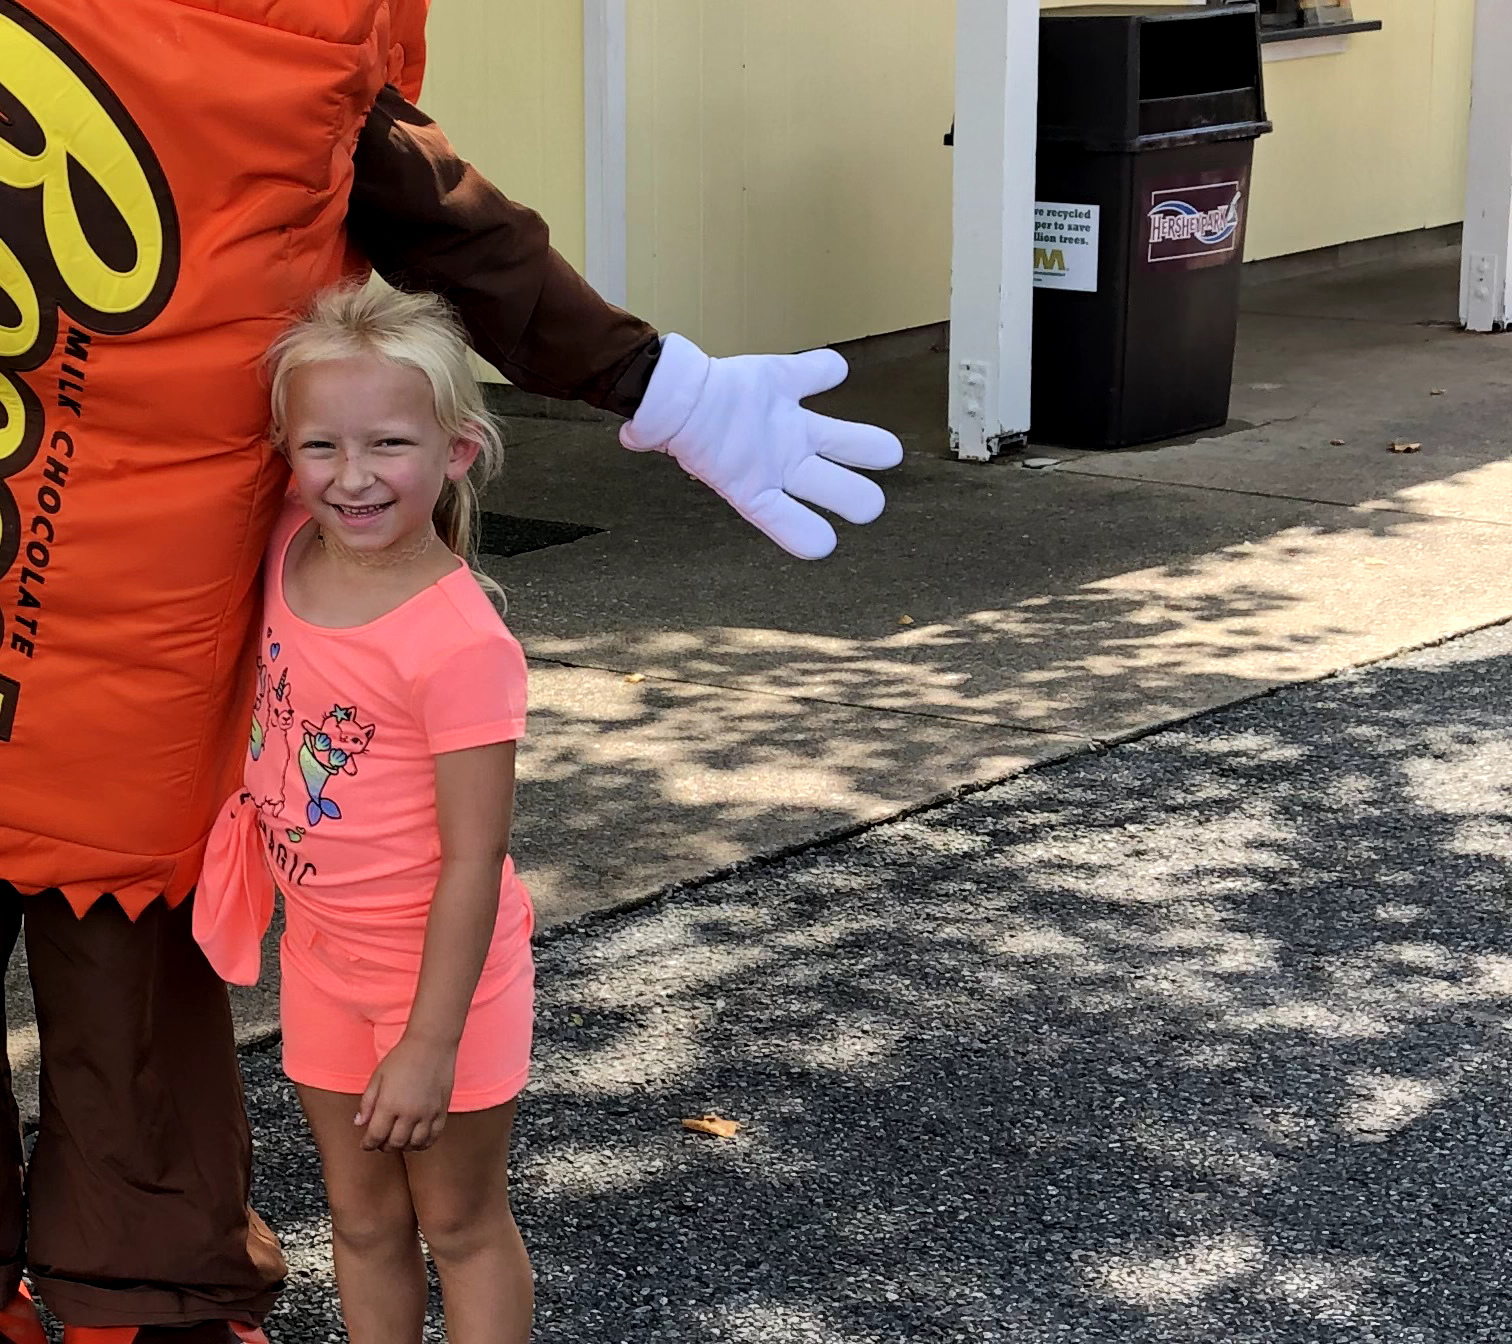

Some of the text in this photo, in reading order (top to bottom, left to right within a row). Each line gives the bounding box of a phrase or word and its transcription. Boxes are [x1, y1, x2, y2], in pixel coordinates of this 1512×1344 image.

[1046, 209, 1091, 221] recycled
[1149, 205, 1230, 243] HERSHEYPARK
[1034, 221, 1091, 233] per to save
[1033, 232, 1089, 246] llion trees.
[1033, 247, 1066, 271] M
[13, 327, 92, 659] MILK CHOCOLATE
